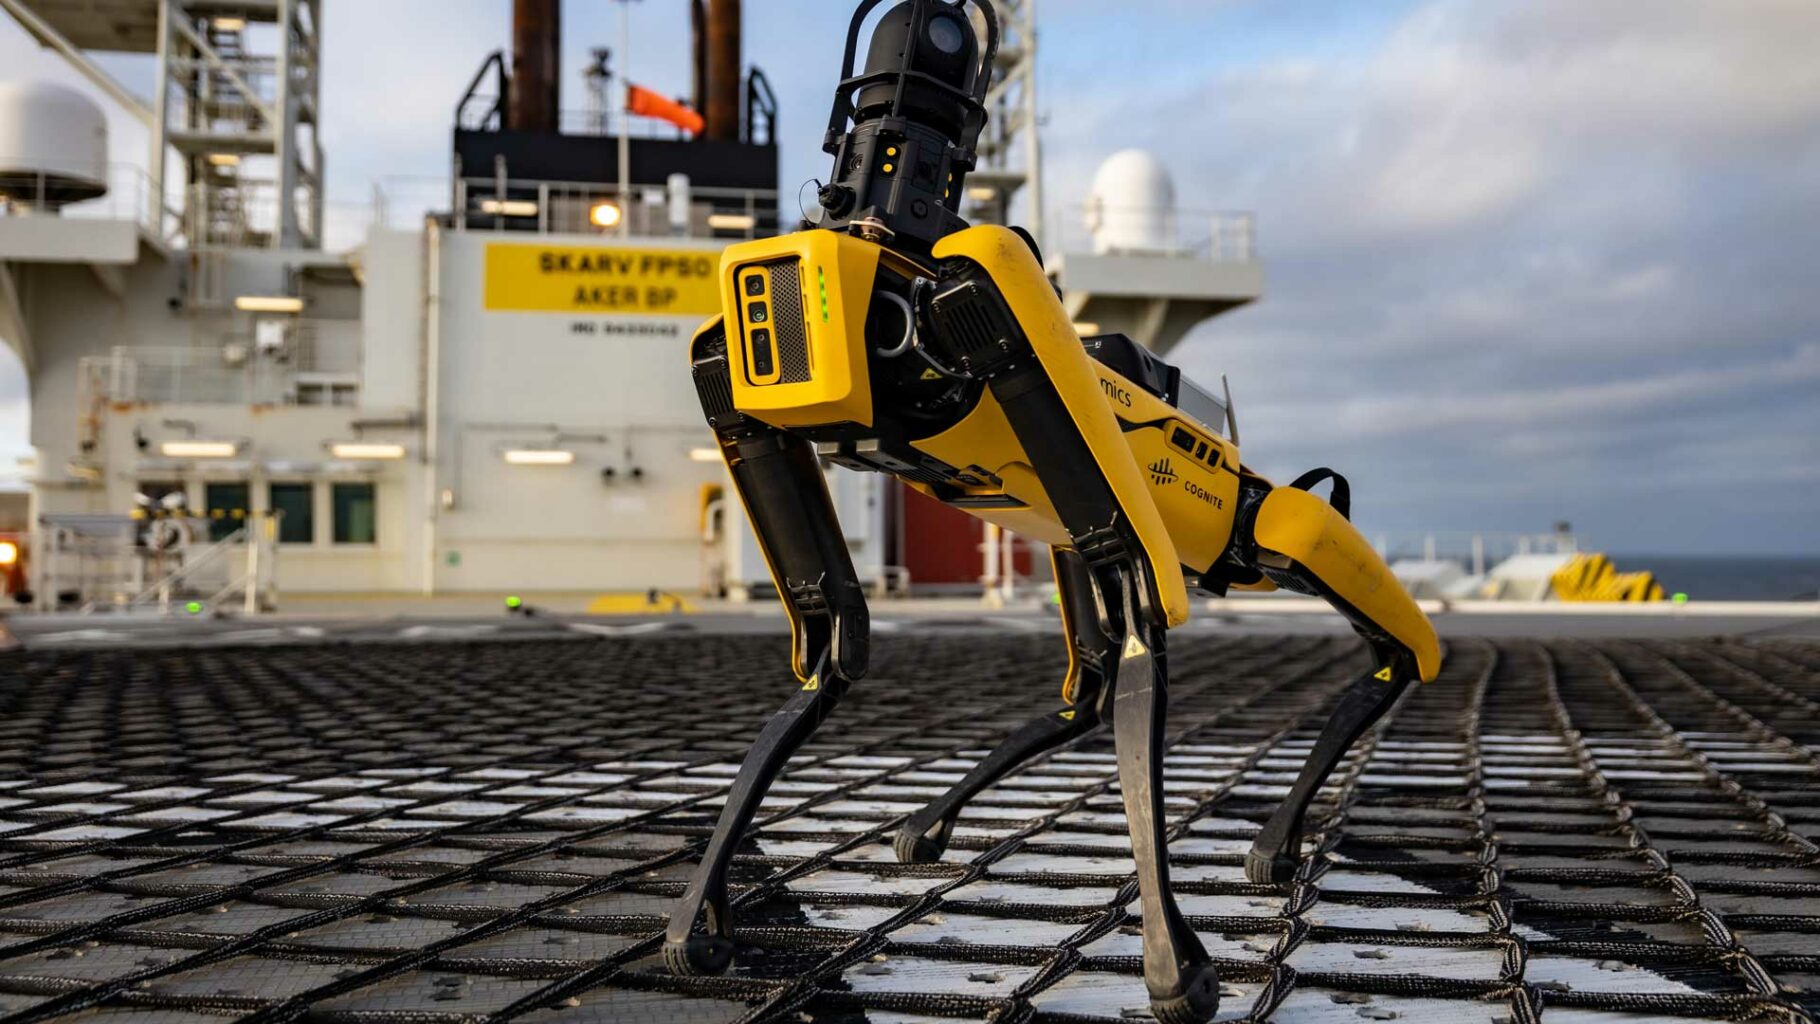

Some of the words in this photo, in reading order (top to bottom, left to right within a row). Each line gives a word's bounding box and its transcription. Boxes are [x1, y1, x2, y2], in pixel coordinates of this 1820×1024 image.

[539, 251, 634, 275] SKARV
[640, 254, 712, 279] FPSO
[573, 284, 639, 307] AKER
[645, 287, 677, 309] BP
[1184, 480, 1224, 511] COGNITE
